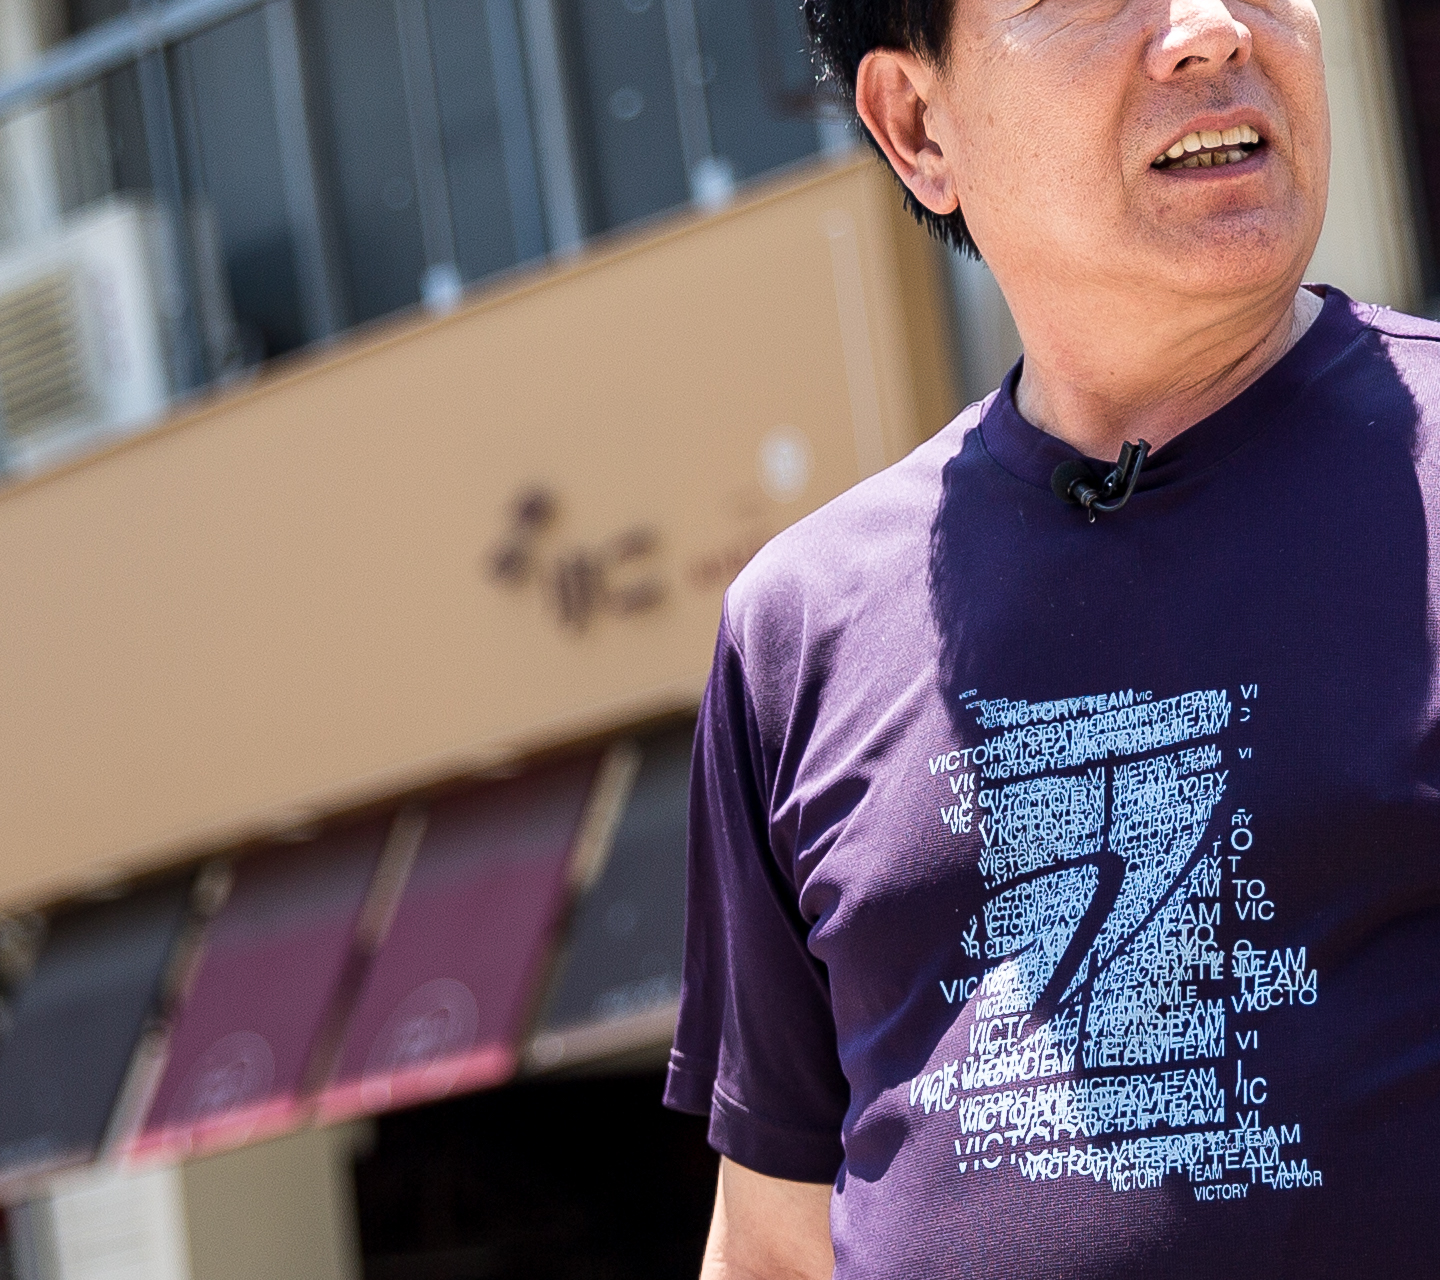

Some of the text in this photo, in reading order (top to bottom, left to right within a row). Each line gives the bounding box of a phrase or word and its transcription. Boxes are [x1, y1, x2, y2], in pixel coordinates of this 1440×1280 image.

[1231, 879, 1266, 899] TO
[1235, 900, 1275, 921] VIC
[1235, 1030, 1258, 1050] VI
[1194, 1183, 1249, 1201] VICTORY
